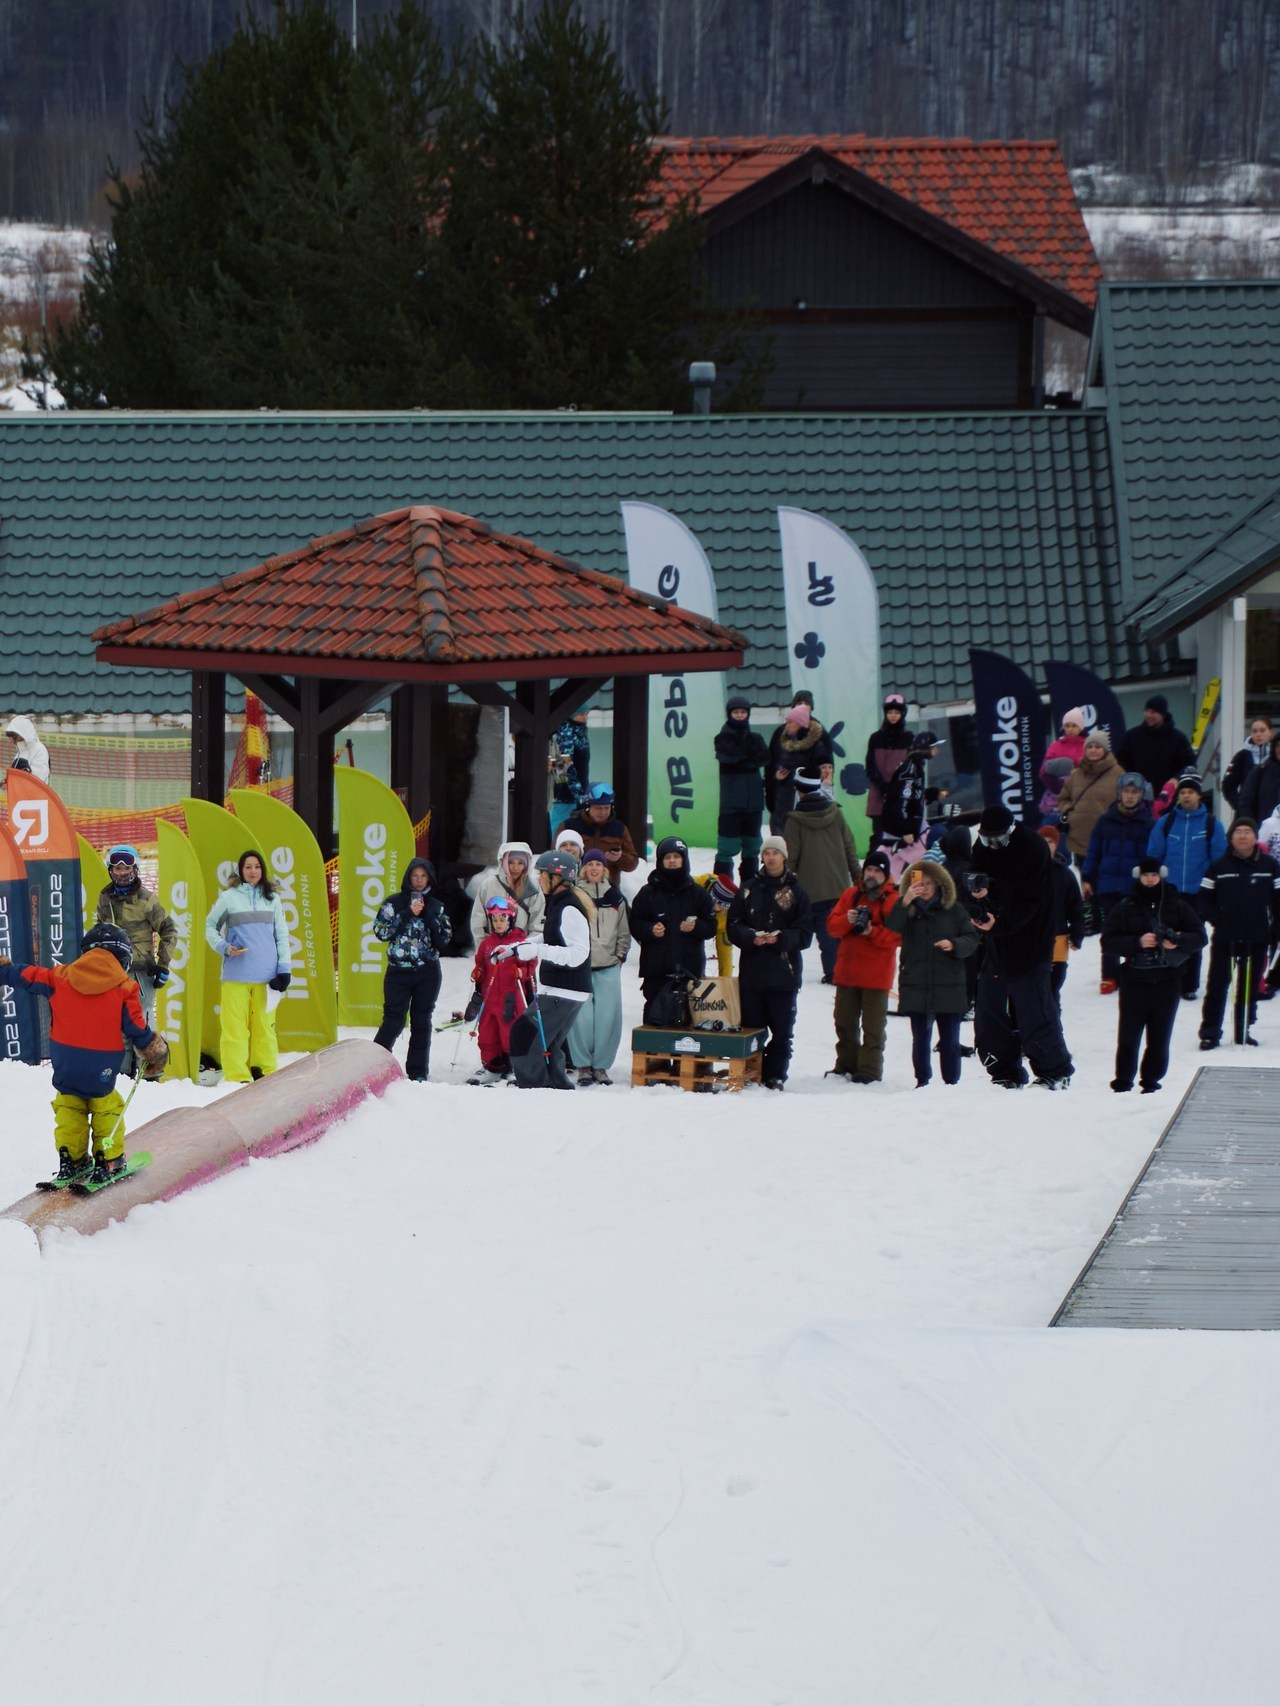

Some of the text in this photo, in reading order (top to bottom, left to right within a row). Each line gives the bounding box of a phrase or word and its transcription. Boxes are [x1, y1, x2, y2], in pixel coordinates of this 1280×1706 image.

[1021, 716, 1034, 802] ENERGY DRINK
[389, 849, 398, 892] DRINK
[300, 873, 317, 978] ENERGY DRINK
